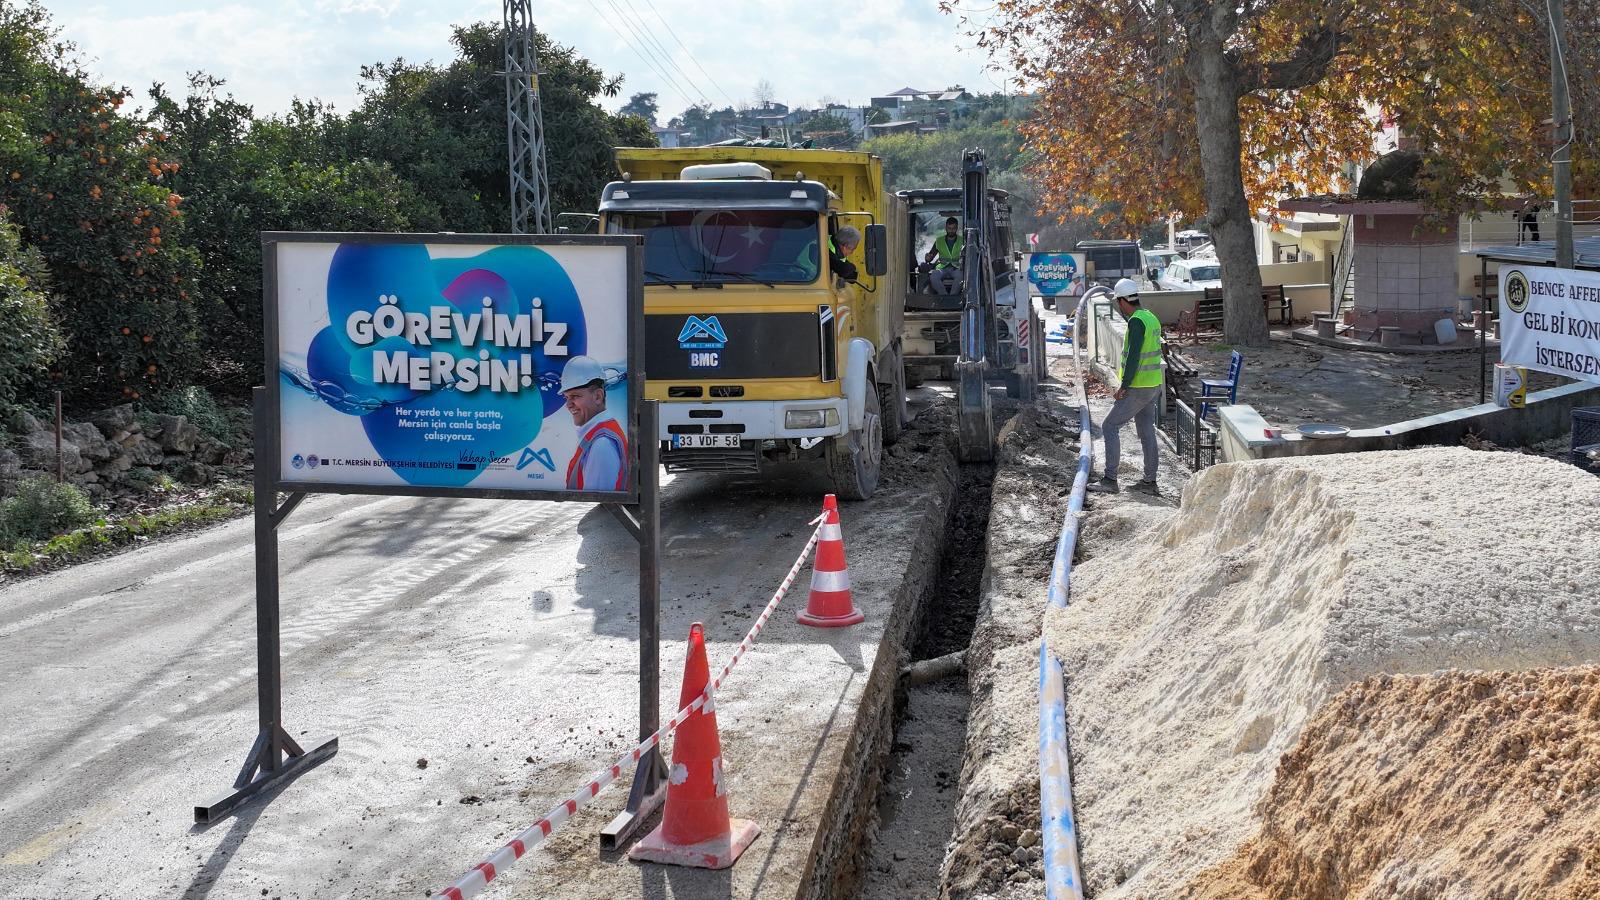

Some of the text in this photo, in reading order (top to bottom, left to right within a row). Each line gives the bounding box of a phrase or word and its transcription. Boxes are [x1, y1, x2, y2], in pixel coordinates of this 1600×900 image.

[1033, 262, 1073, 273] GÖREVİMİZ
[1037, 271, 1068, 280] MERSİN!
[1531, 281, 1565, 298] BENCE
[346, 295, 568, 356] GÖREVİMİZ
[1523, 311, 1600, 341] GEL Bİ KON
[691, 352, 719, 367] BMC
[373, 349, 532, 393] MERSİN!
[395, 407, 412, 416] Her
[415, 408, 440, 418] yerde
[456, 408, 471, 417] her
[474, 410, 504, 420] şartta,
[398, 419, 501, 431] Mersin için canla başla
[424, 431, 475, 442] çalışıyoruz.
[680, 436, 693, 446] 33
[699, 436, 719, 446] VDF
[725, 436, 738, 446] 58
[345, 457, 371, 467] MERSİN
[373, 458, 416, 469] BÜYÜKŞEHİR
[418, 459, 455, 469] BELEDİYESİ
[460, 448, 486, 467] Vahap
